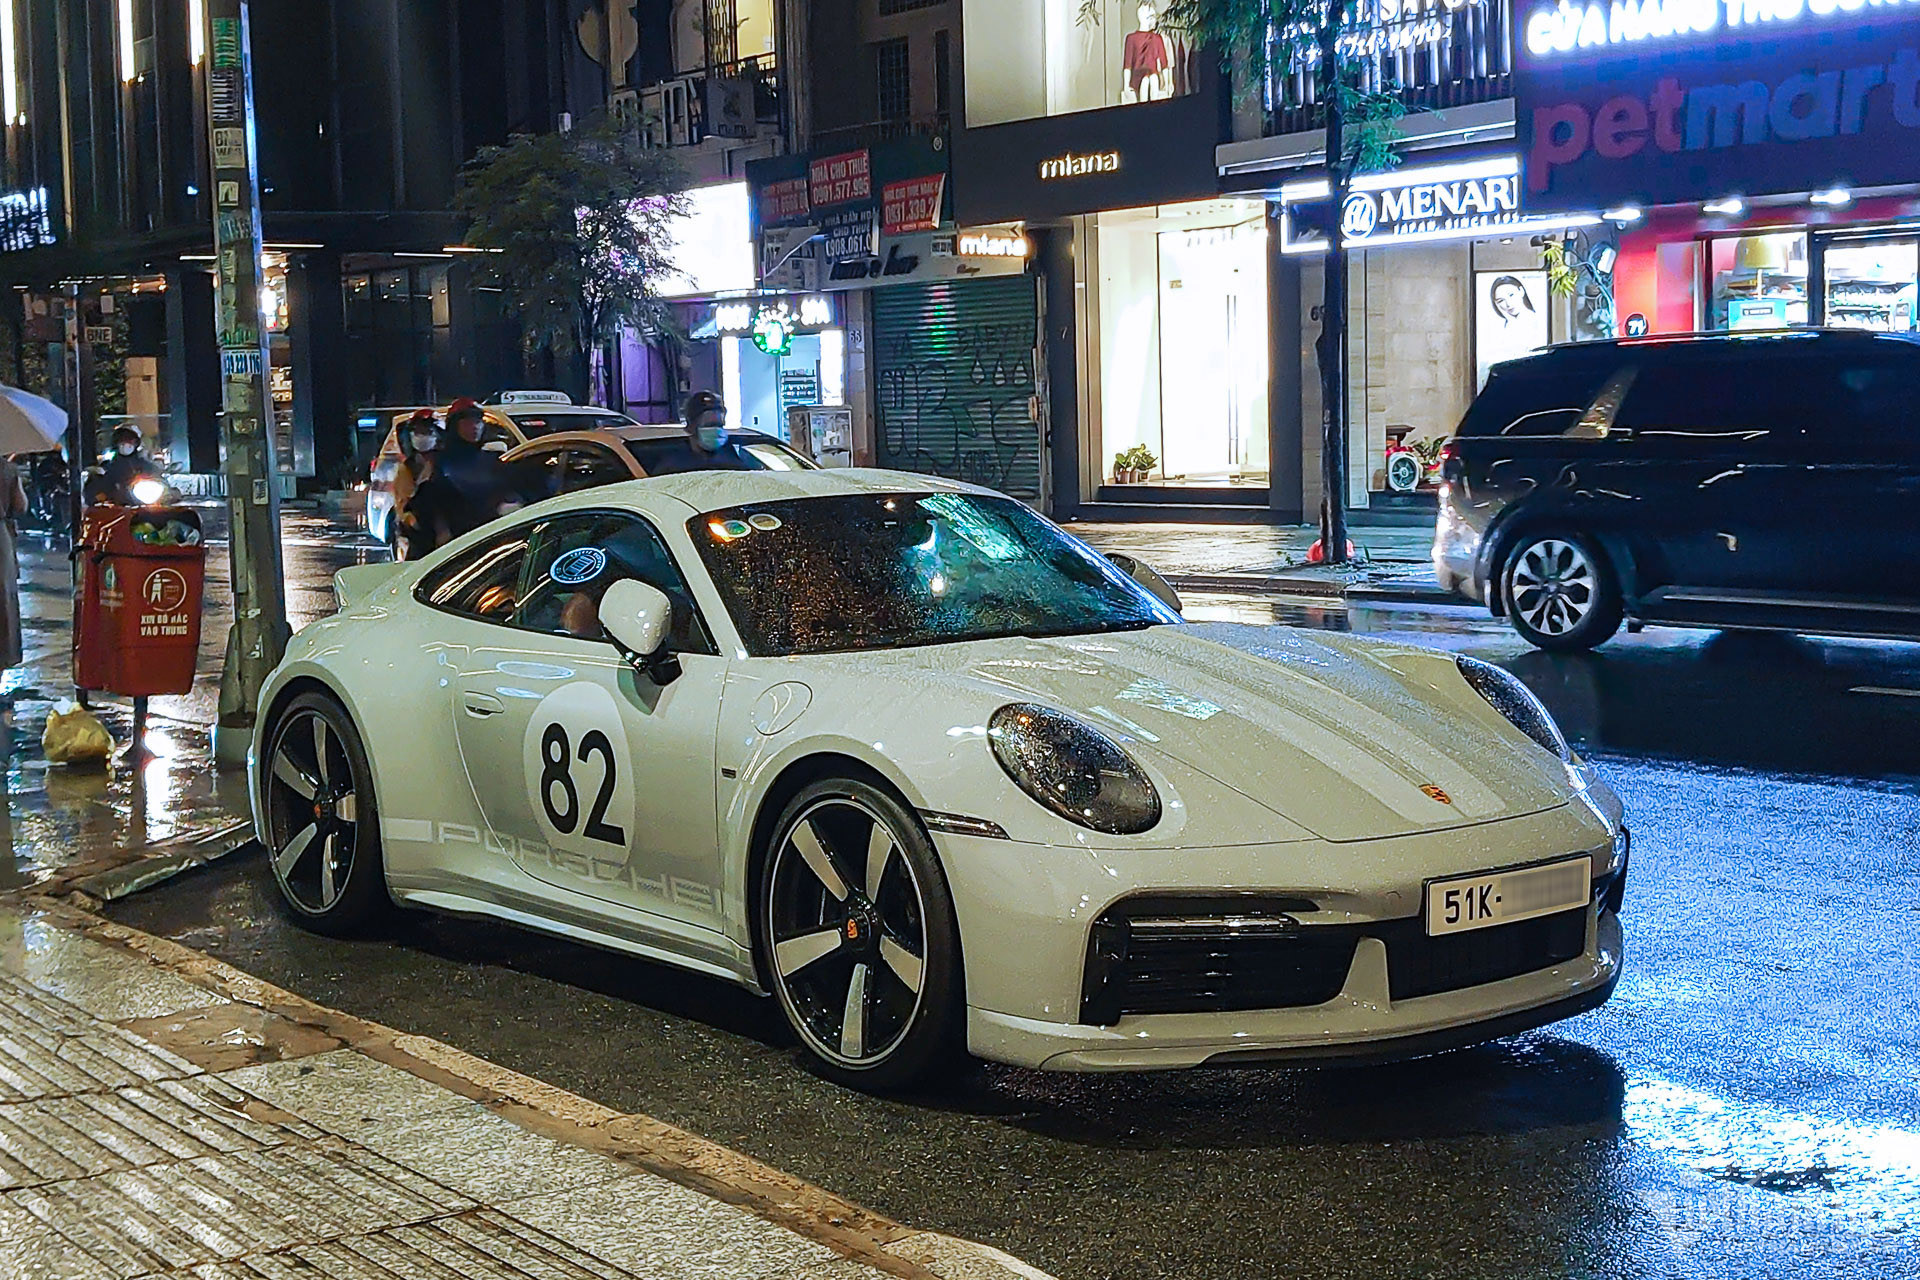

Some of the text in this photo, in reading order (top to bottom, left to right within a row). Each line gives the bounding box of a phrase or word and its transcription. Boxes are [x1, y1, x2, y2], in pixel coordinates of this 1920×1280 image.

[829, 162, 846, 179] CHO
[1378, 175, 1518, 224] MENAR
[540, 721, 626, 847] 82
